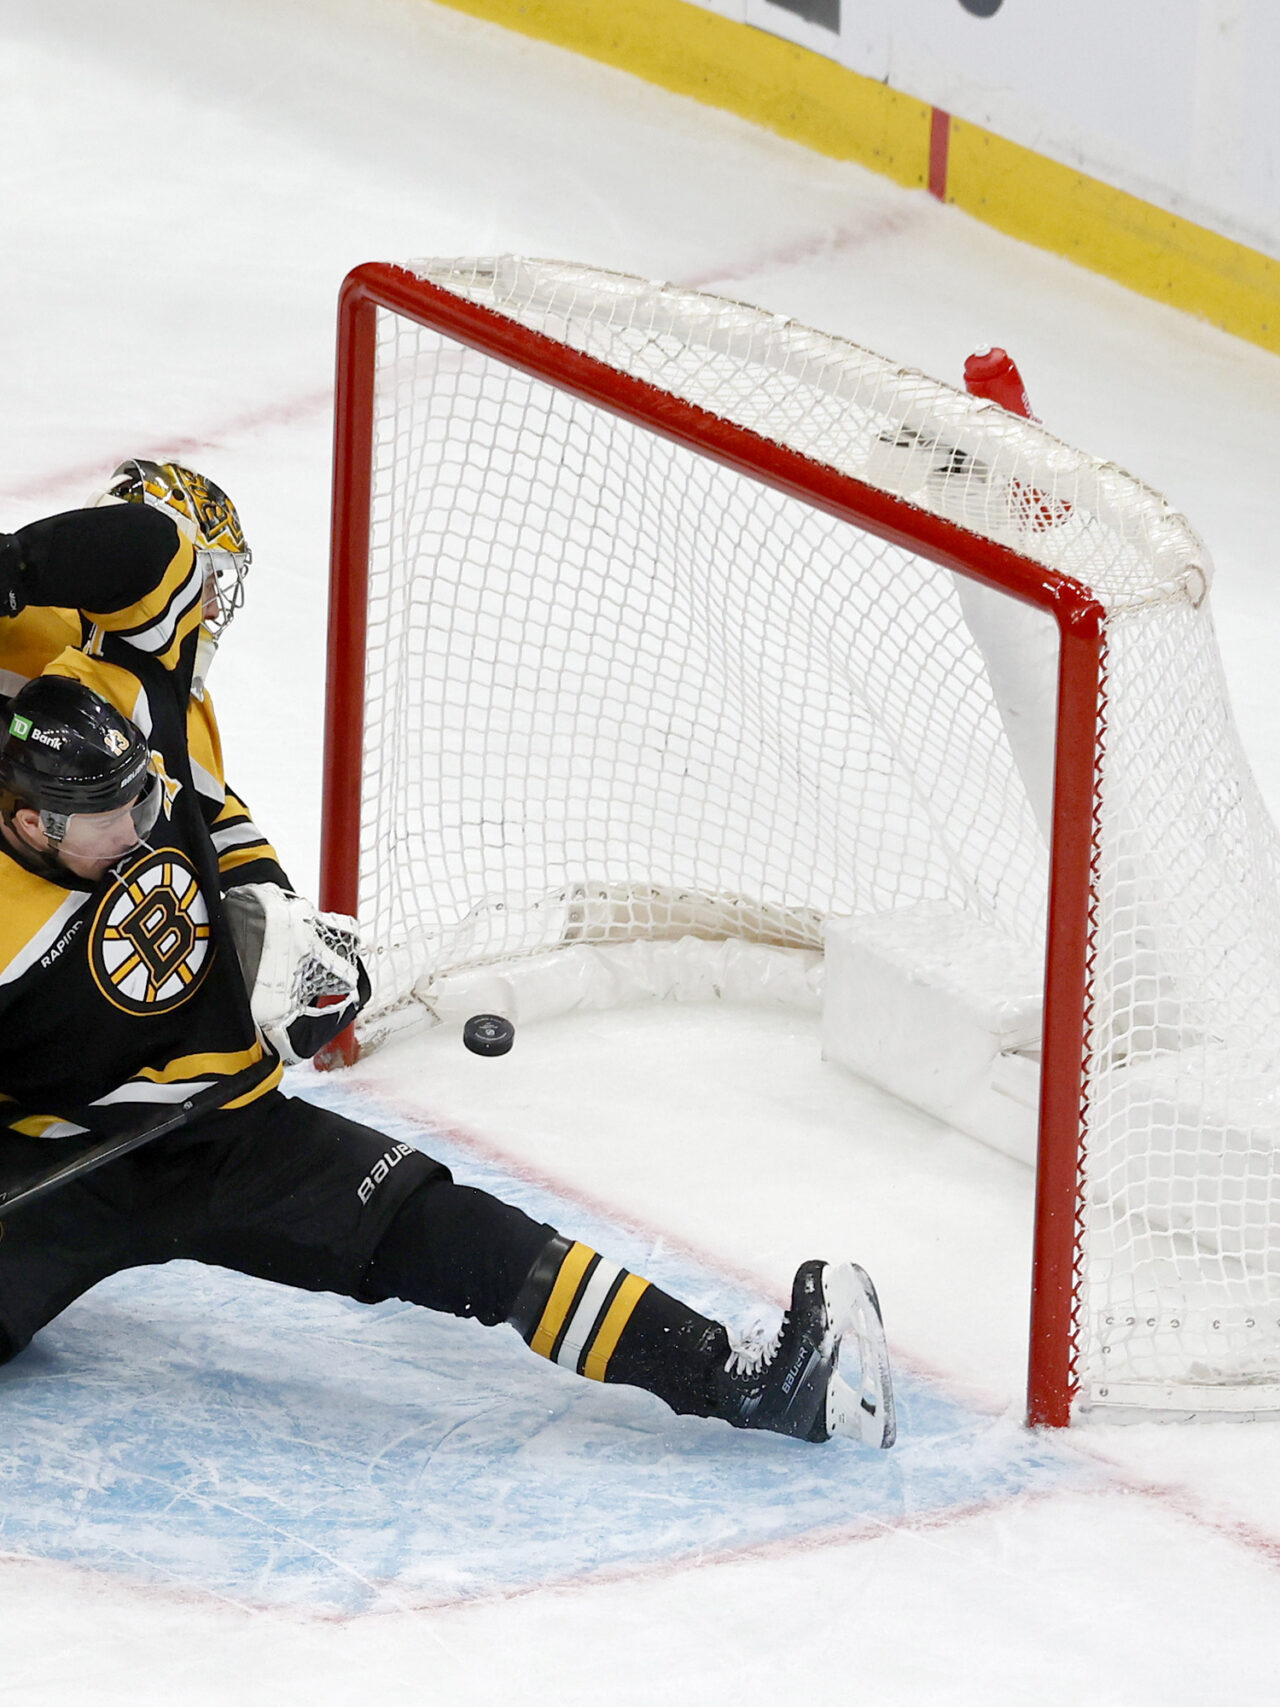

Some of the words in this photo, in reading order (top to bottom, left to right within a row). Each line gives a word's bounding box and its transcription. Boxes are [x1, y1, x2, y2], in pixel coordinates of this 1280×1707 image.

[31, 728, 63, 750] Bank
[118, 886, 195, 989] B
[357, 1143, 417, 1205] BAUE
